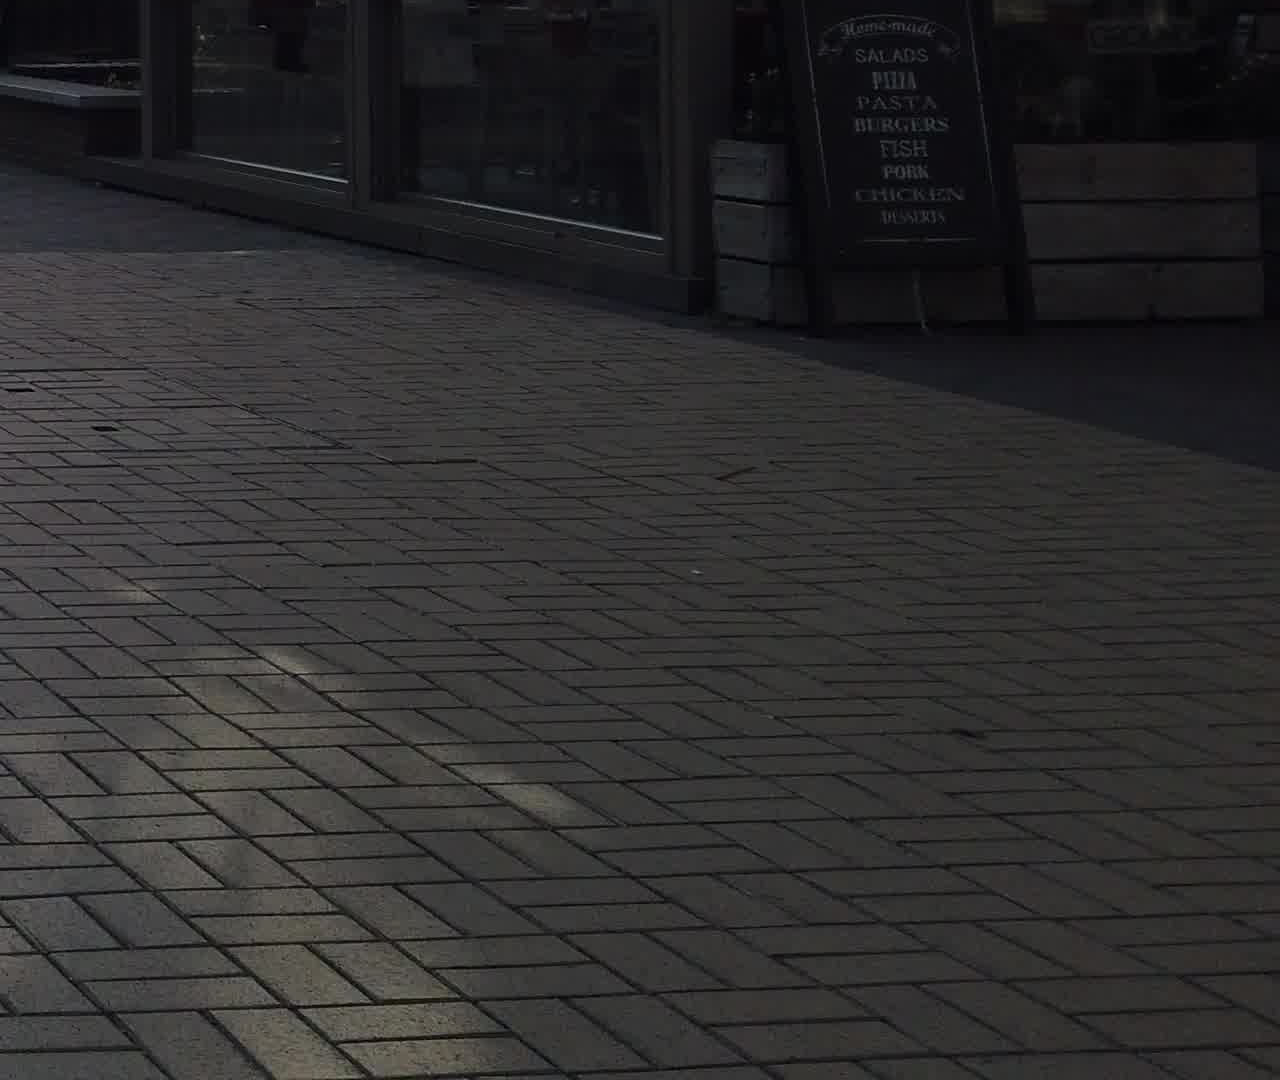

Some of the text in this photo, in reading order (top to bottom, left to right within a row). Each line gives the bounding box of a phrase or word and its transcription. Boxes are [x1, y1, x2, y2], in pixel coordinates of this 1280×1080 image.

[855, 48, 929, 64] SALADS
[855, 95, 938, 111] PASTA
[854, 117, 951, 135] BURGERS
[879, 140, 929, 158] FISH
[882, 164, 930, 181] PORK
[854, 187, 966, 202] CHICKEN
